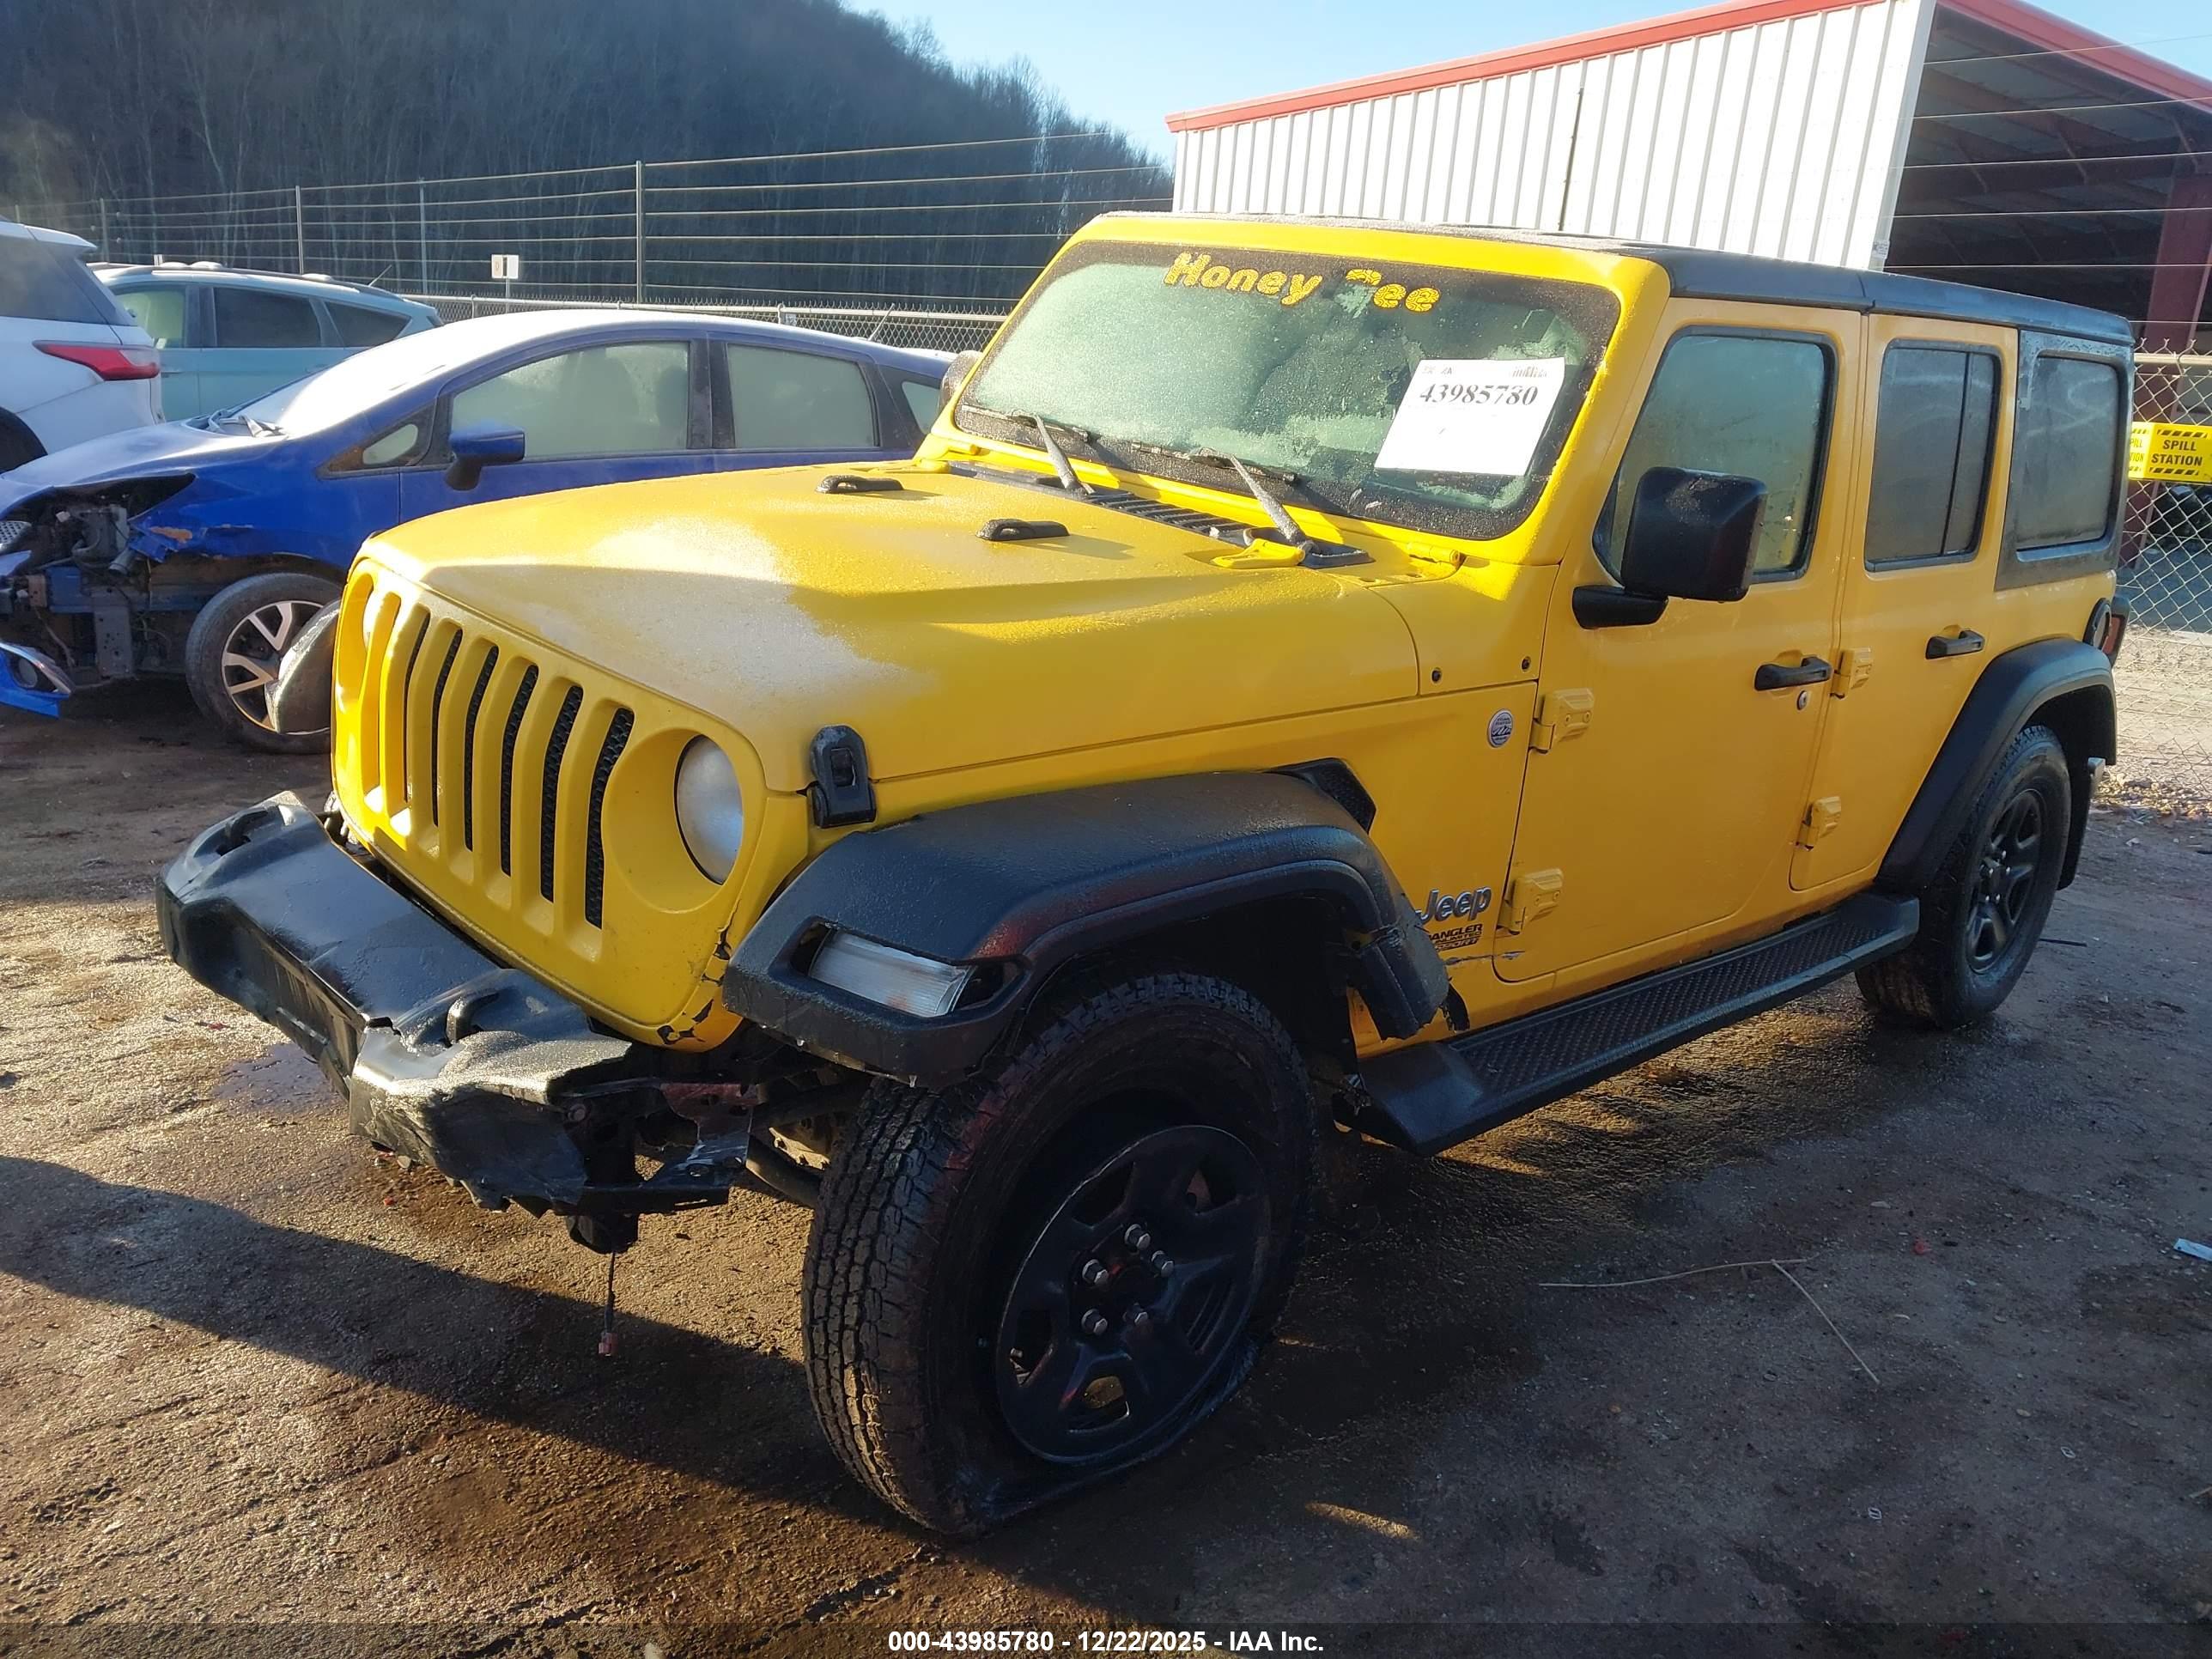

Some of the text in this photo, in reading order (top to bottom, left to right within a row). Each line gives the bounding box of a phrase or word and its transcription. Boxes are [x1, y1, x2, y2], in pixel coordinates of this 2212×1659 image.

[1163, 252, 1323, 307] Honey
[1419, 383, 1539, 405] 43985780
[2163, 439, 2197, 451] SPILL
[2151, 453, 2203, 466] STATION
[1414, 886, 1492, 923] Jeep
